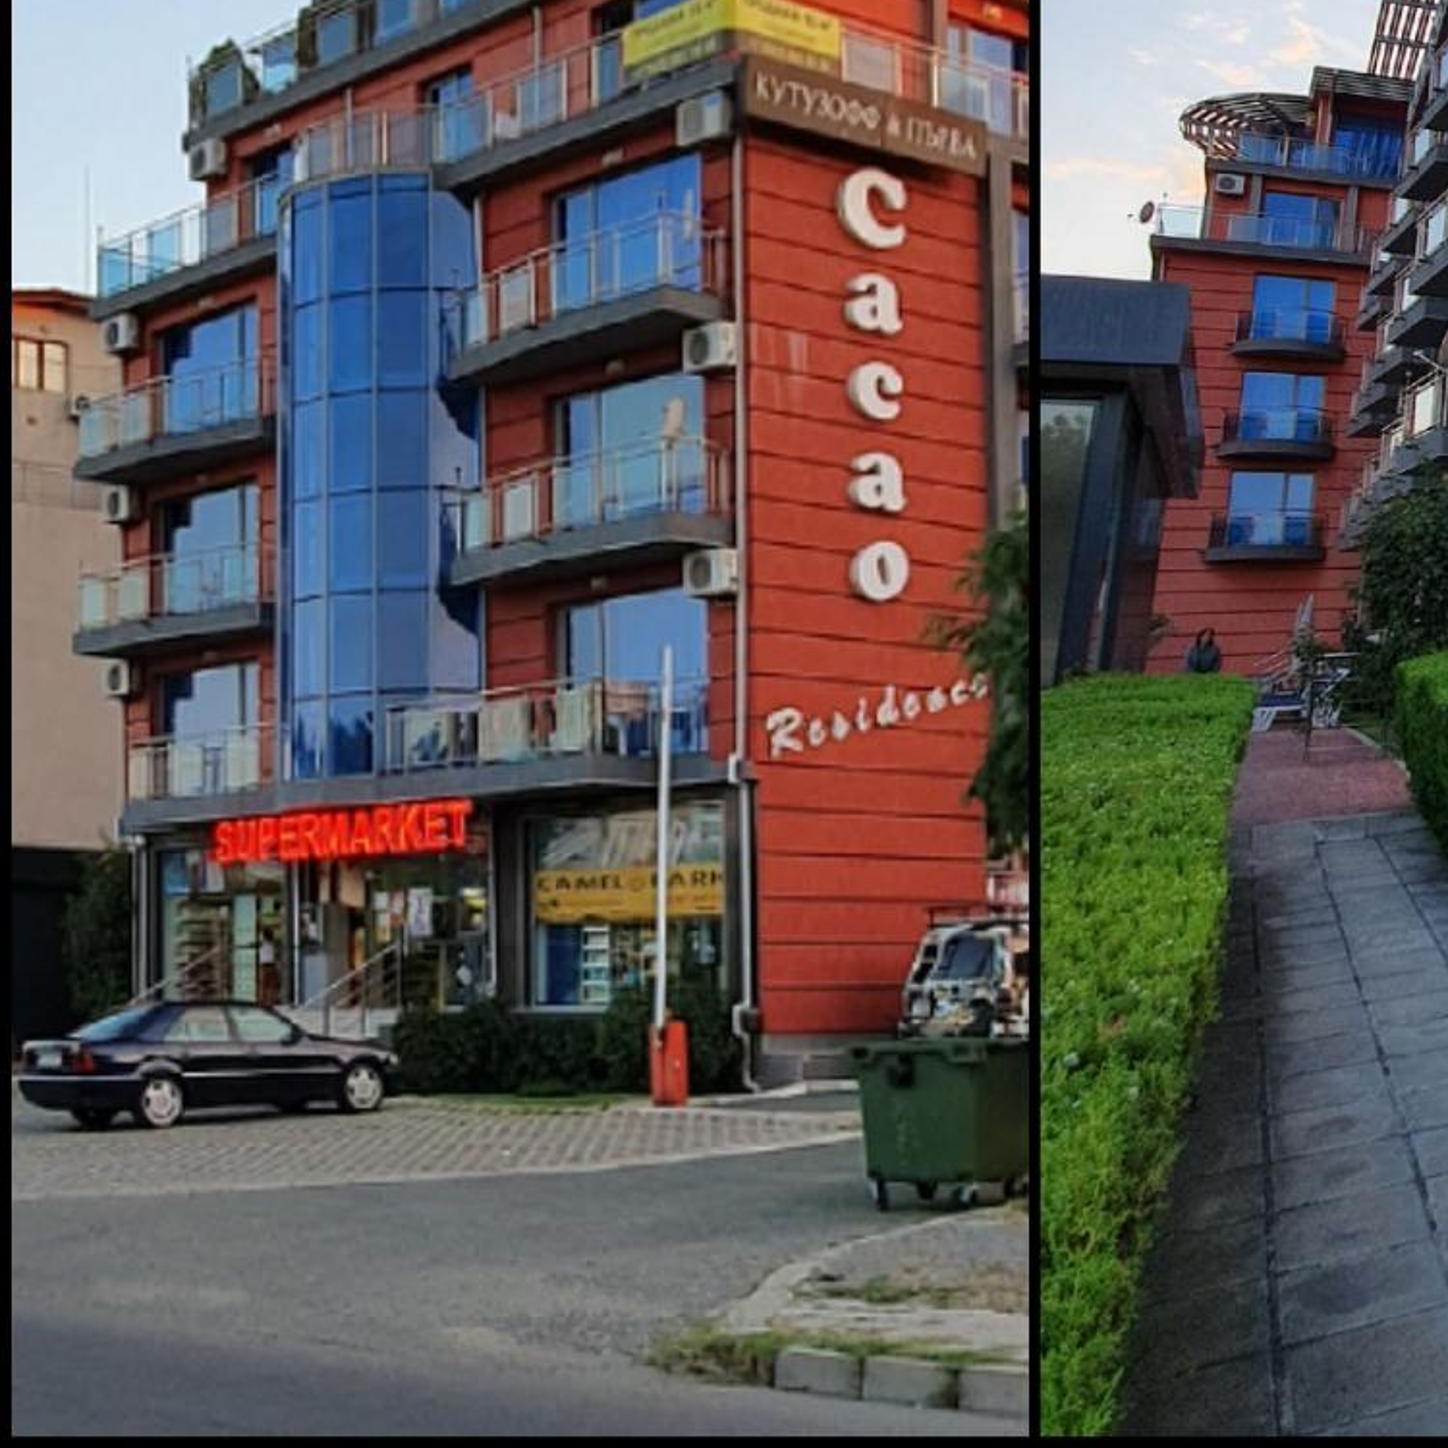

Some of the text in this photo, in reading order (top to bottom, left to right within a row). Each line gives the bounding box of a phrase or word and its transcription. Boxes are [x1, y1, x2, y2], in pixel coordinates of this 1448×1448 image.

[755, 70, 881, 130] КУТУЗОФФ
[836, 166, 911, 602] Cacao
[766, 672, 988, 758] Residence
[213, 798, 474, 863] SUPERMARKET
[537, 873, 623, 892] CAMEL
